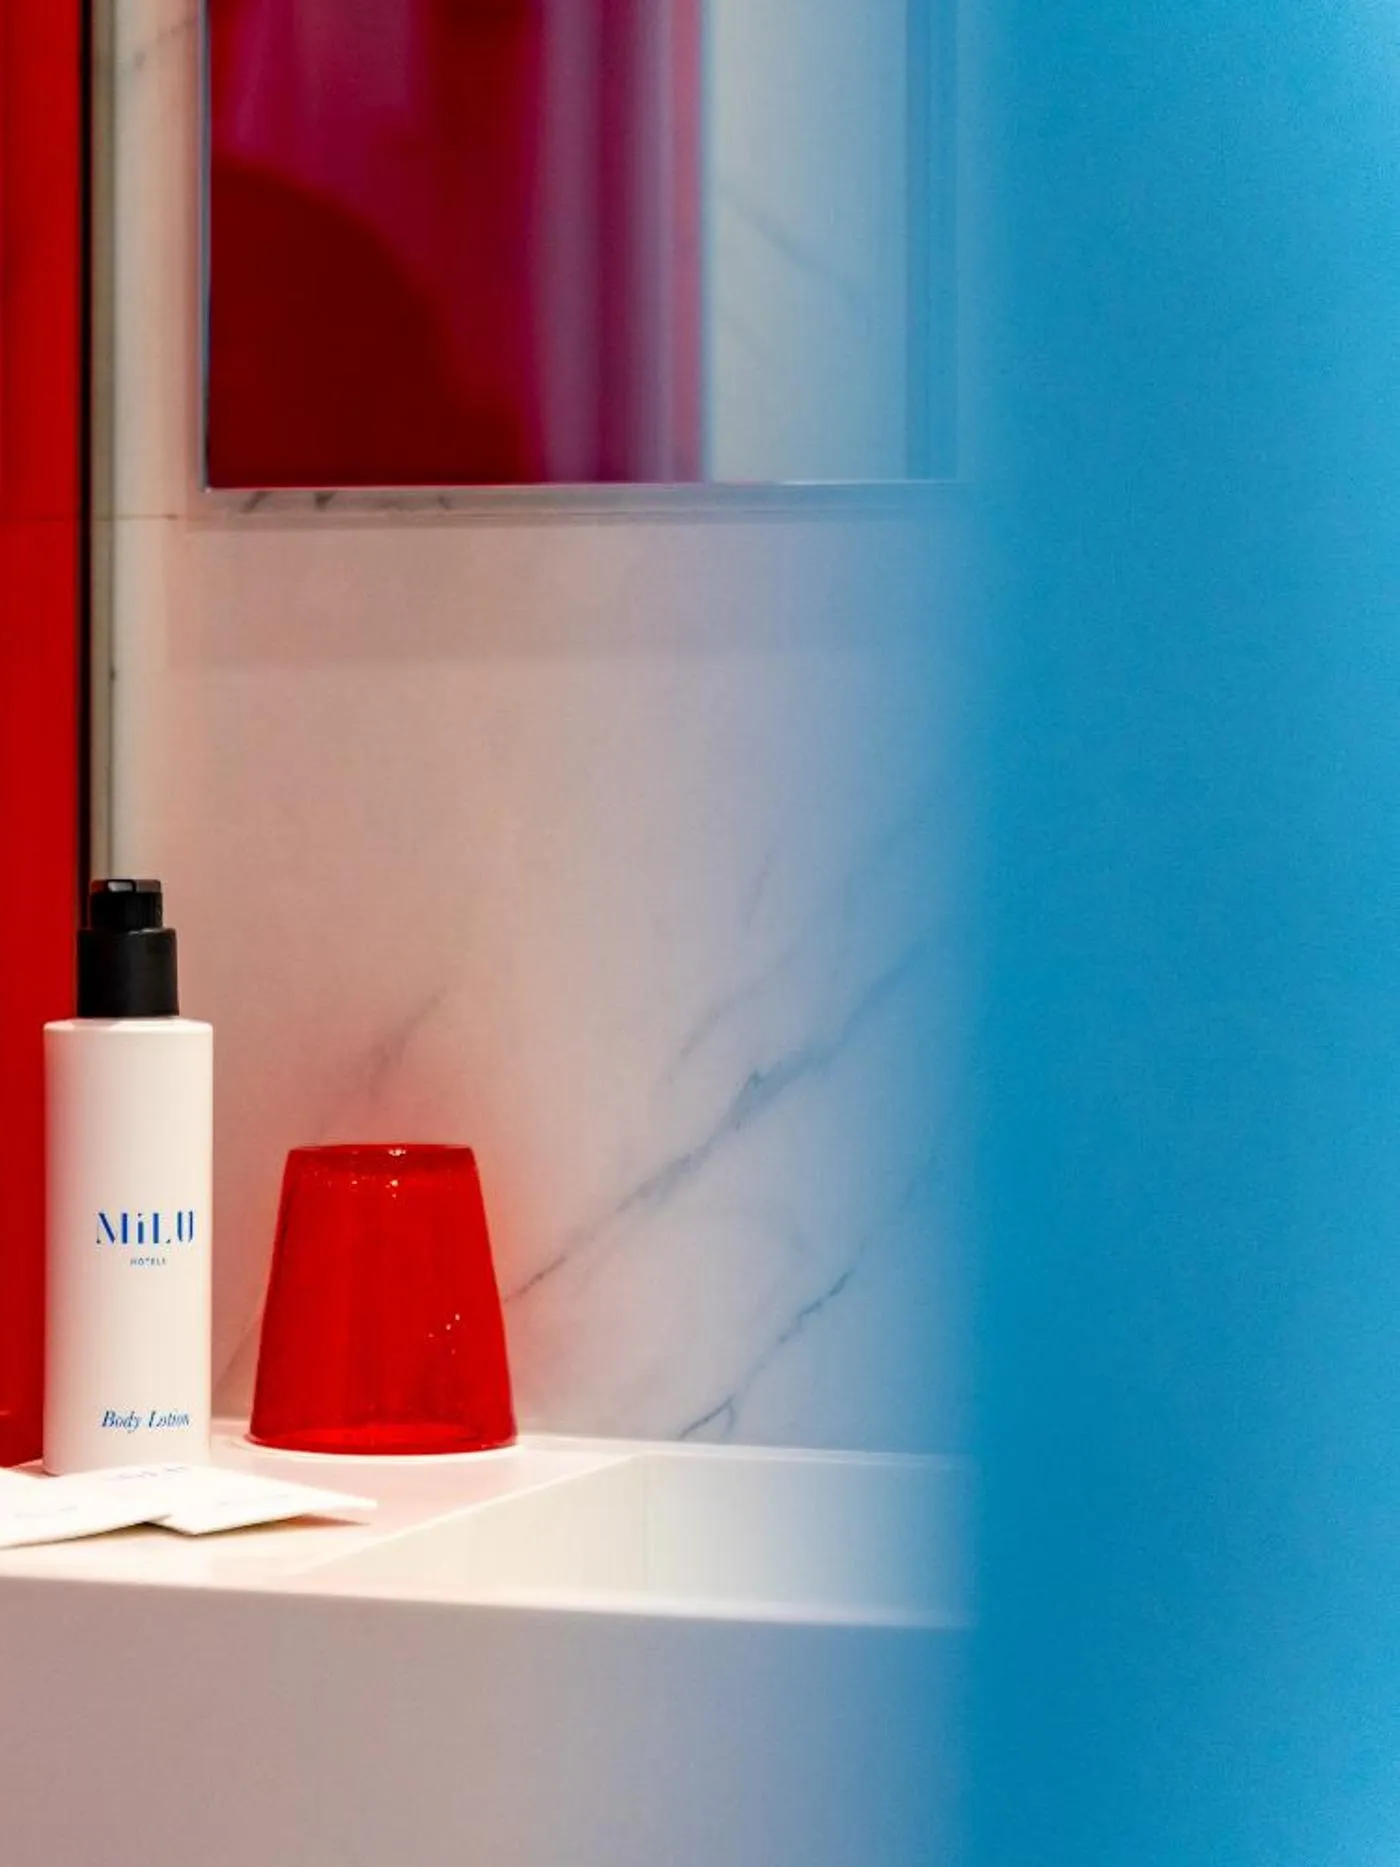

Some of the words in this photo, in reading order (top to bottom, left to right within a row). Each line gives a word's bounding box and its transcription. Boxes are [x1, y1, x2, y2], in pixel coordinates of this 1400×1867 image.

[95, 1210, 194, 1245] MiLU
[130, 1257, 167, 1267] HOTELS
[101, 1409, 141, 1433] Body
[147, 1410, 190, 1429] Lotion
